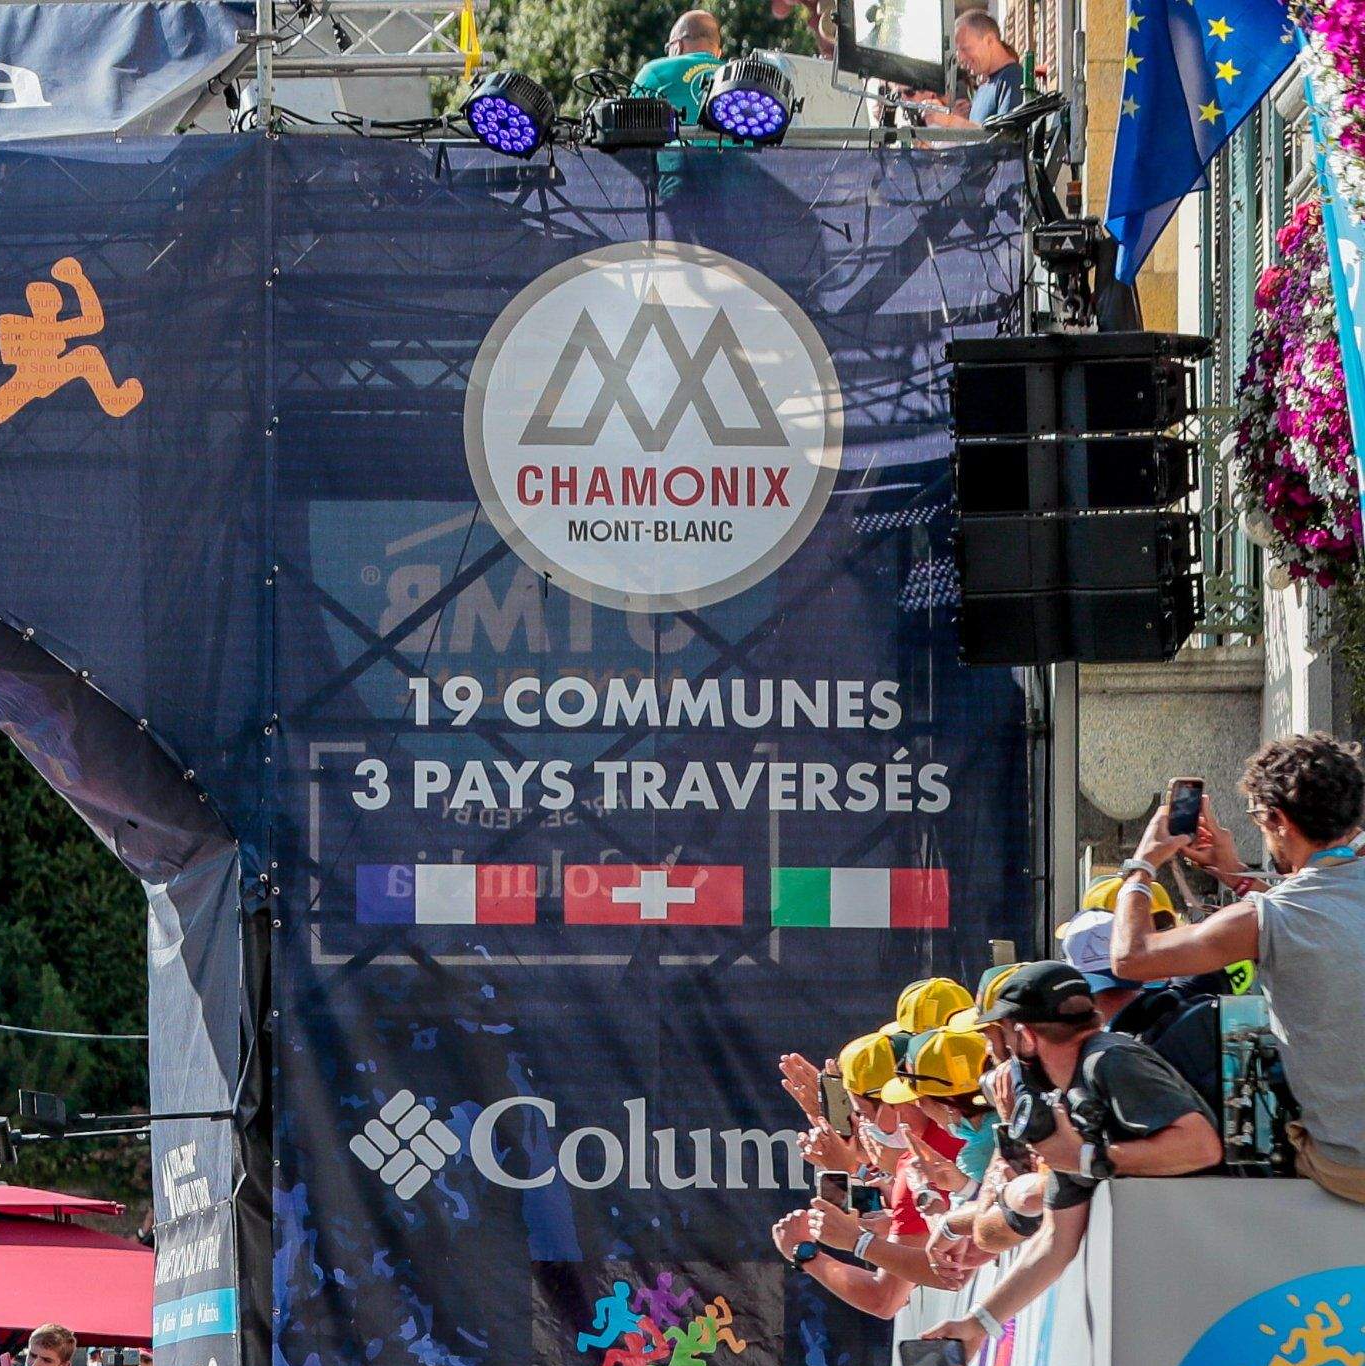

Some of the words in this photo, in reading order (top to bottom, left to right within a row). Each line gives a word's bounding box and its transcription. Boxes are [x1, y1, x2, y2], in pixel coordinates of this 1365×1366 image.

[516, 465, 791, 509] CHAMONIX
[567, 519, 733, 543] MONT-BLANC
[408, 676, 484, 727] 19
[502, 676, 903, 731] COMMUNES
[352, 758, 391, 810] 3
[413, 759, 575, 810] PAYS
[593, 748, 951, 813] TRAVERSÉS
[469, 1095, 817, 1191] Colum
